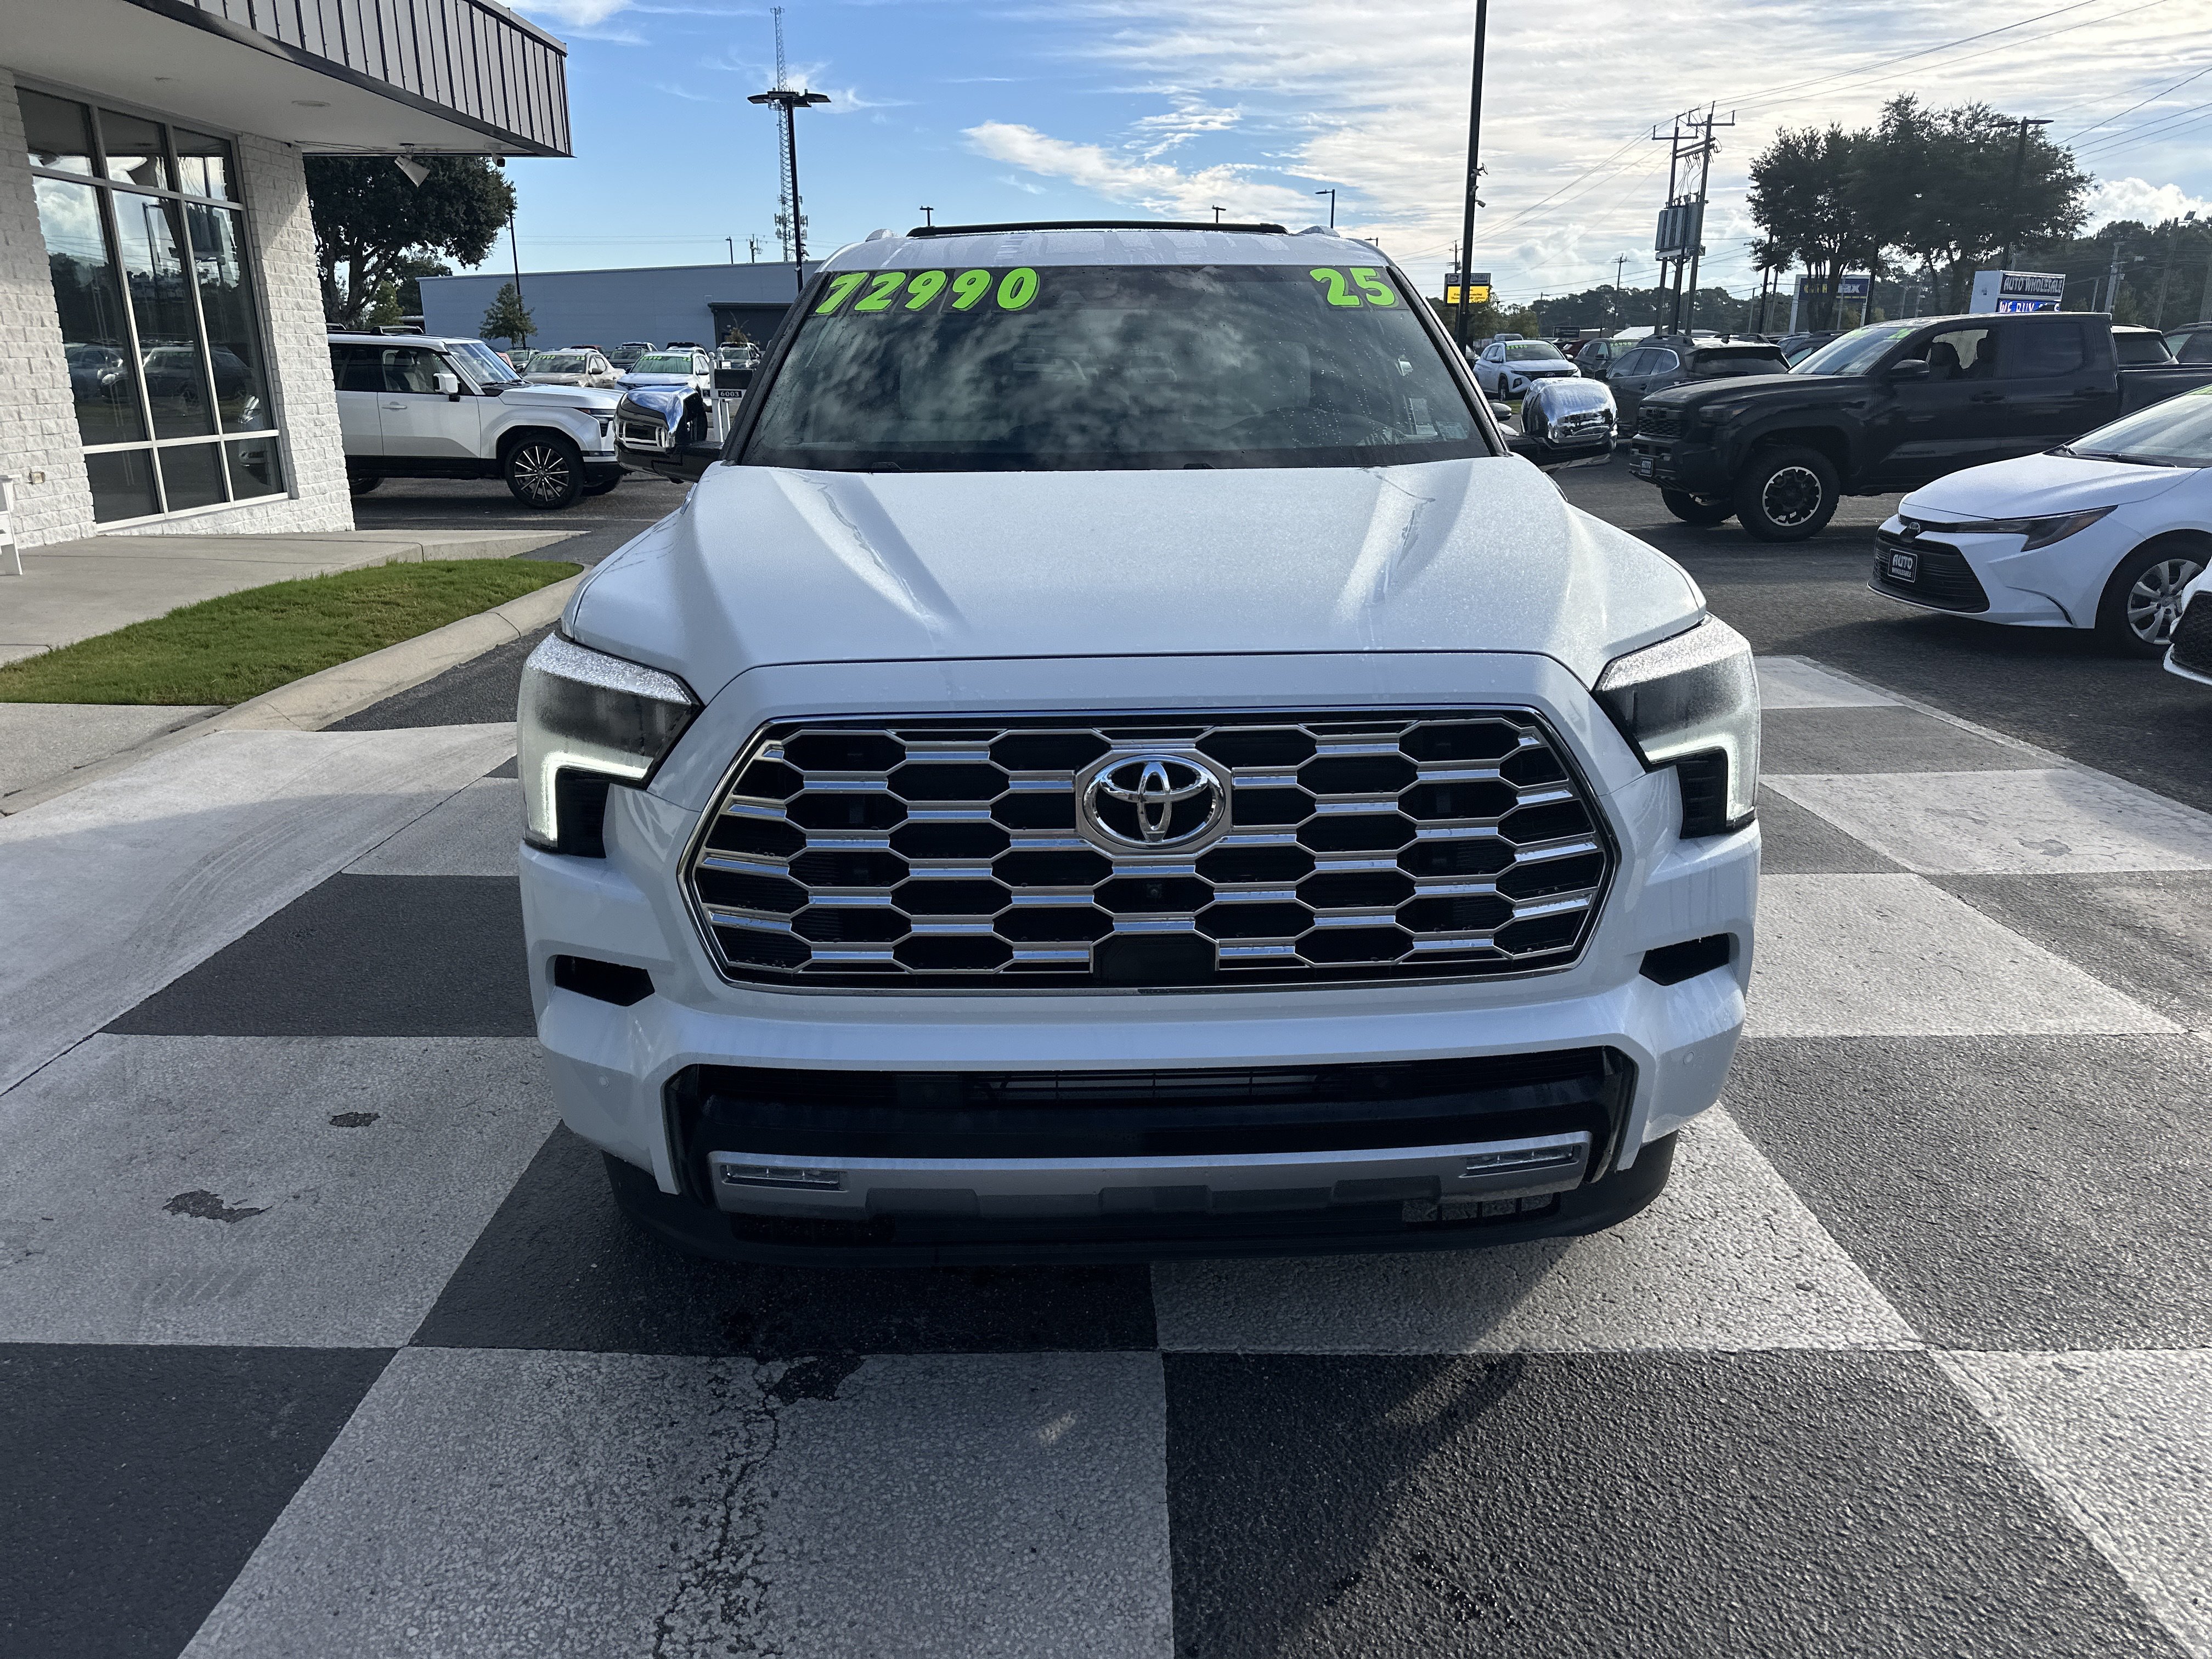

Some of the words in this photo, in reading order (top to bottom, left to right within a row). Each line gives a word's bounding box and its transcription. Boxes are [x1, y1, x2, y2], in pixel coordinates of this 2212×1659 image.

[815, 268, 1040, 314] 72990
[1310, 267, 1399, 308] 25
[2004, 276, 2024, 292] AUTO
[2025, 277, 2063, 294] WHOLESALE
[1893, 554, 1913, 569] AUTO
